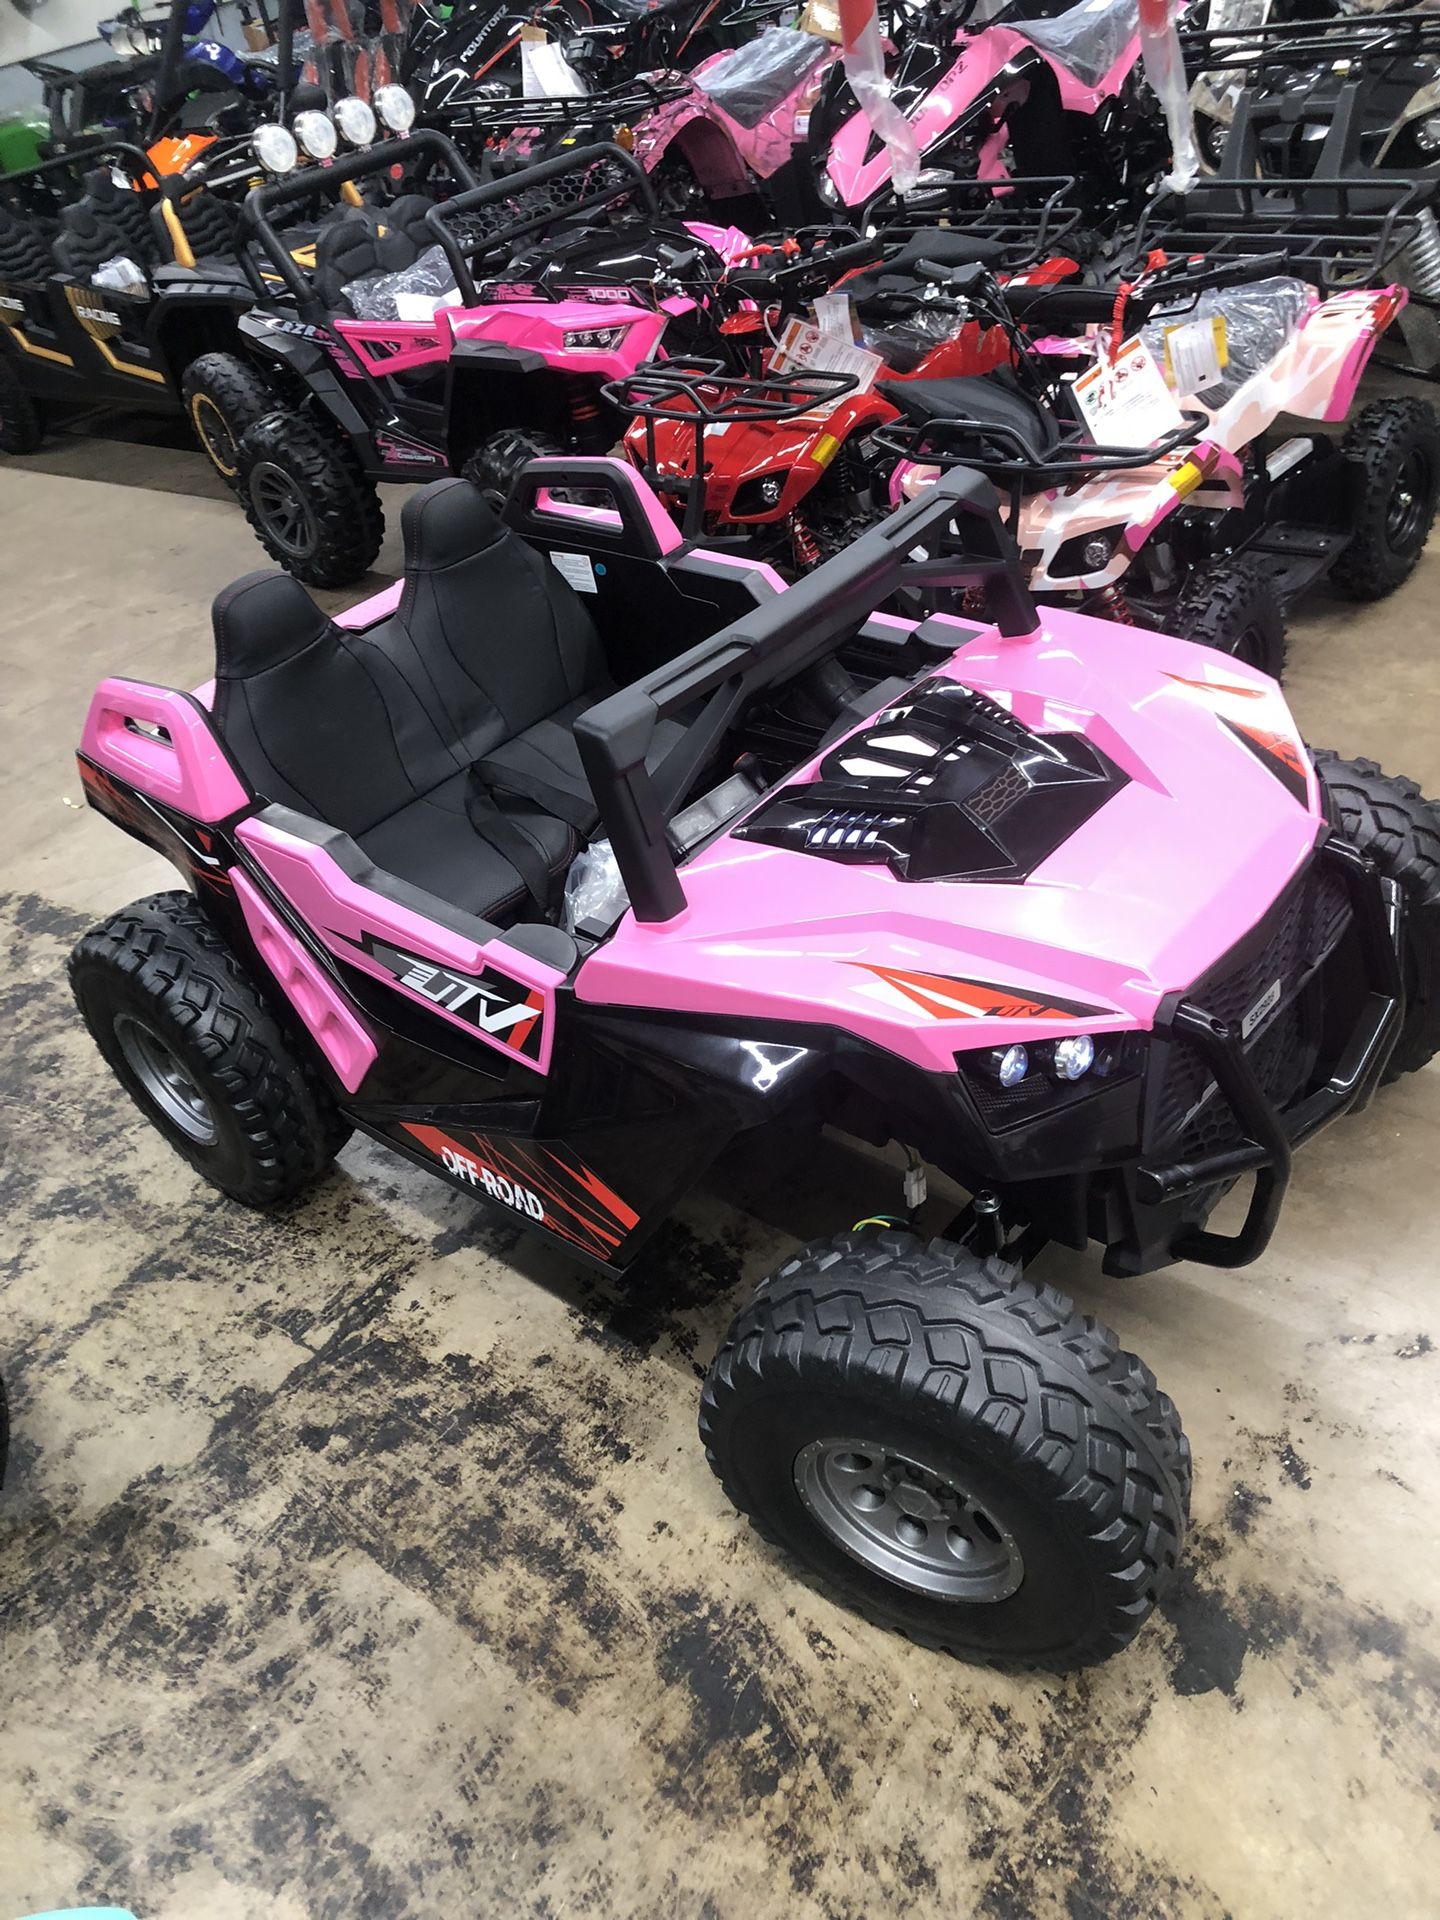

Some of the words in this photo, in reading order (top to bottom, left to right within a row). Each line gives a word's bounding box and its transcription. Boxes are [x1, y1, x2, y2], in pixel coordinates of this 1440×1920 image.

[76, 305, 122, 326] RACING
[588, 288, 630, 301] 1000
[397, 953, 543, 1033] UTV
[440, 1145, 546, 1222] OFF-ROAD
